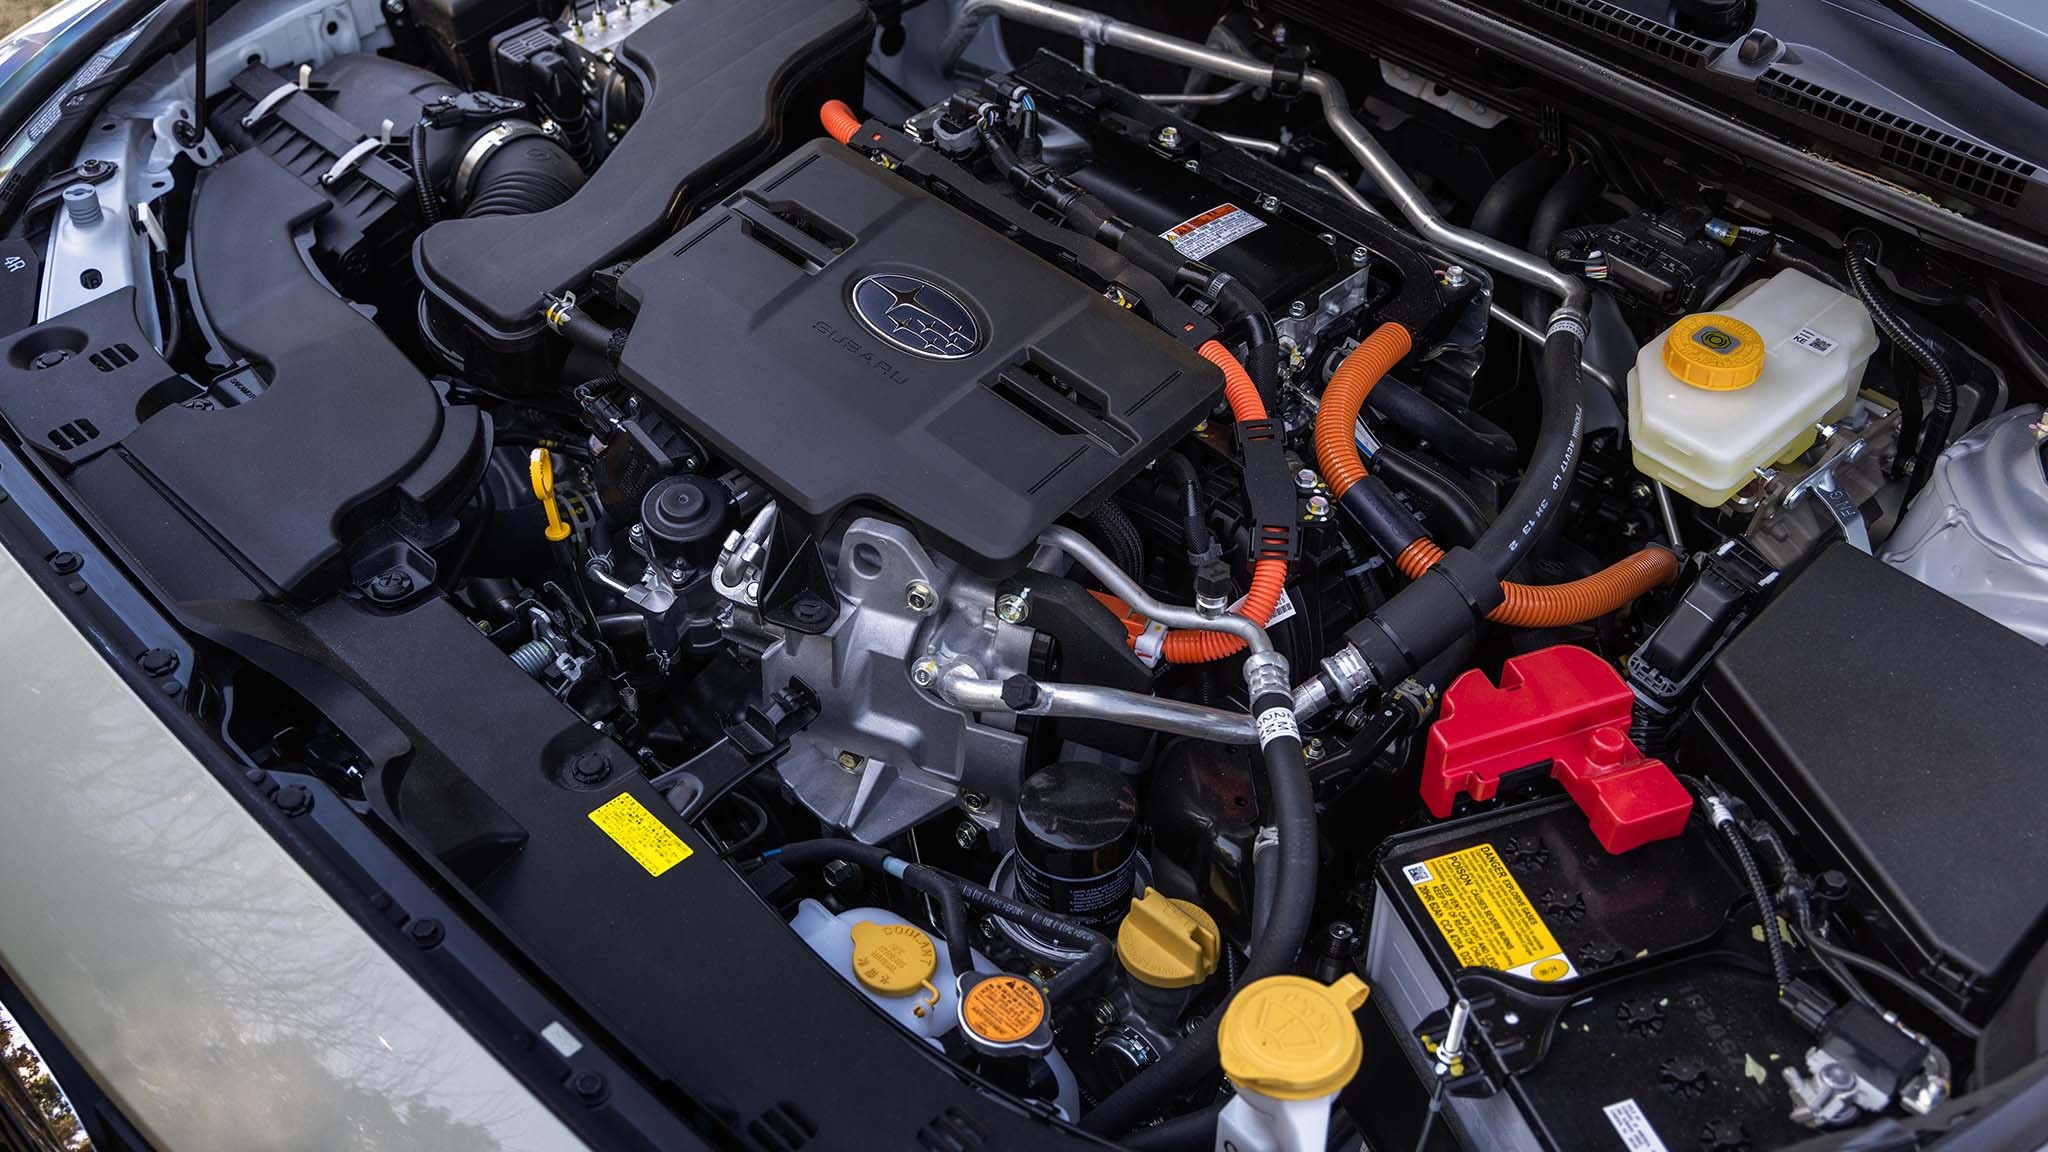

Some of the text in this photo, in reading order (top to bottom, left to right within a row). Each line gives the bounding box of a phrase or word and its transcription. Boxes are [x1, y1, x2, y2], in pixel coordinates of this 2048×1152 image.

[1793, 335, 1808, 345] KE
[812, 321, 910, 385] SUBARU
[1552, 474, 1562, 490] LP
[1522, 520, 1536, 535] 13
[1508, 540, 1519, 551] 2
[1430, 884, 1446, 900] KEEP
[1479, 845, 1539, 926] DANGER EXPLOSIVE GASES
[1439, 898, 1454, 911] OUT
[1446, 855, 1474, 886] POISON
[1469, 888, 1489, 910] CAUSES
[1482, 909, 1502, 931] SEVERE
[1496, 929, 1515, 950] BURNS
[1438, 882, 1454, 898] KEEP
[1447, 896, 1463, 911] VENT
[1456, 910, 1473, 926] CAPS
[1466, 925, 1483, 942] TIGHT
[1476, 941, 1490, 954] AND
[1447, 910, 1459, 919] OF
[1438, 918, 1456, 935] CCA
[1452, 917, 1471, 938] REACH
[884, 926, 933, 968] COOLANT
[1463, 936, 1475, 946] OF
